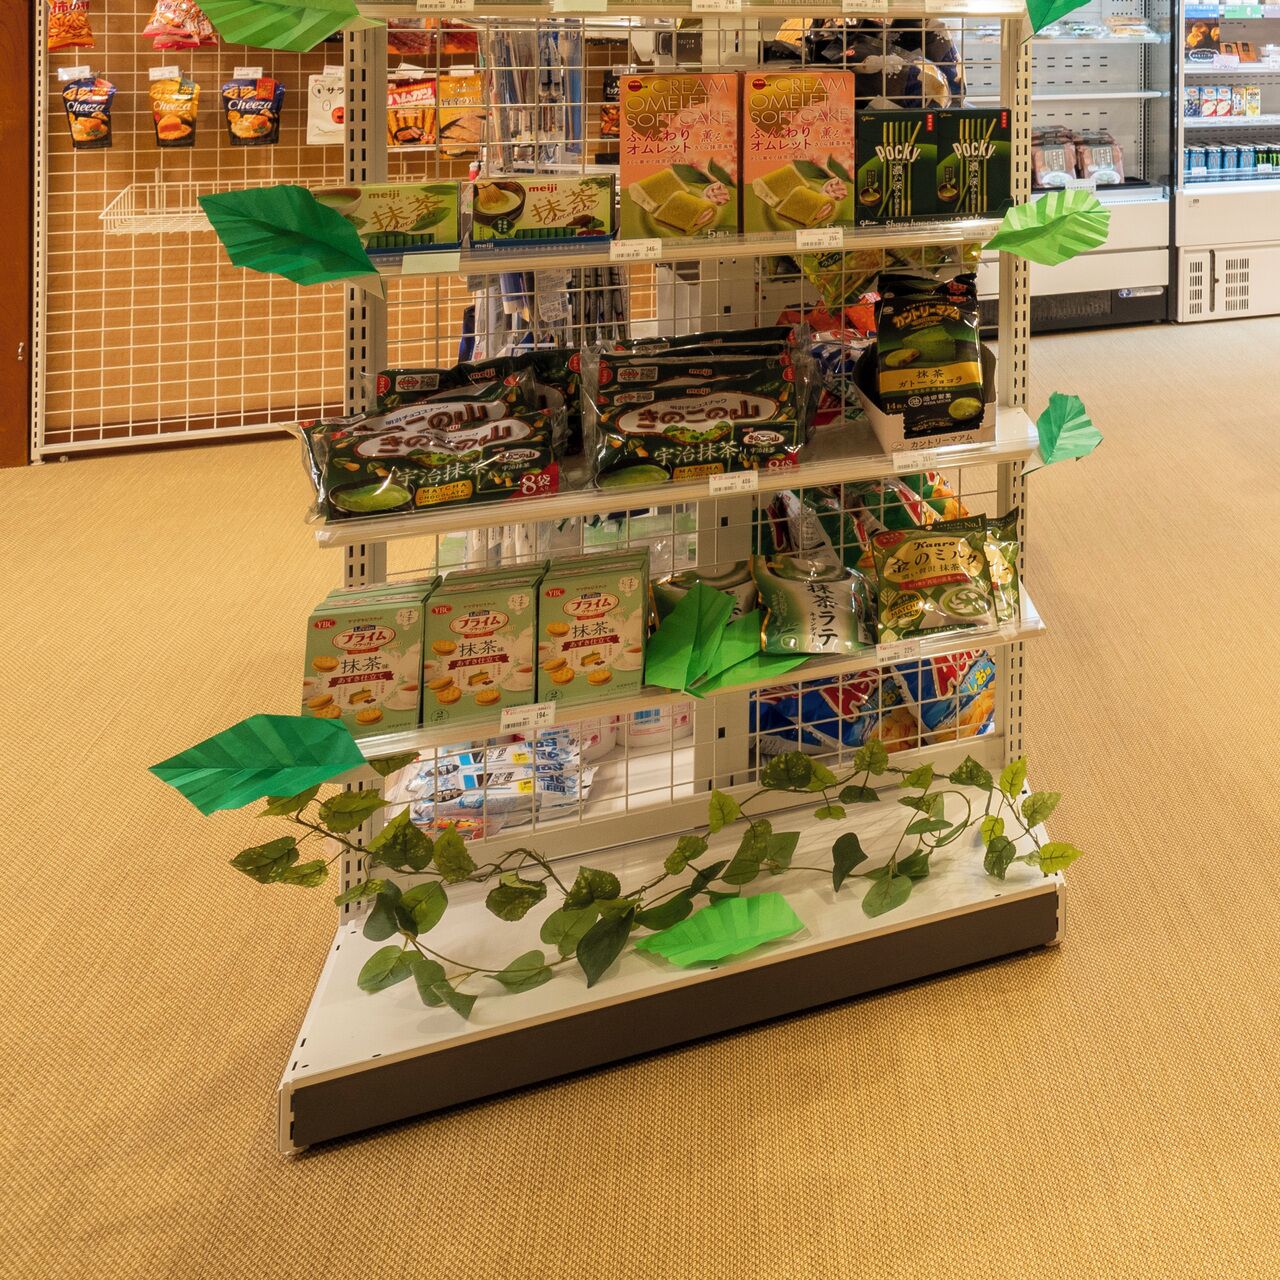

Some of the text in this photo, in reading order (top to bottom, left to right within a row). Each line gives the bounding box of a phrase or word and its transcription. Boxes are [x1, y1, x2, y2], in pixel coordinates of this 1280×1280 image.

[651, 79, 728, 95] CREAM
[774, 77, 847, 93] CREAM
[66, 100, 105, 113] Cheeza
[152, 100, 192, 112] Cheeza
[227, 98, 273, 111] Cheeza
[626, 95, 710, 112] OMELET
[751, 93, 830, 110] OMELET
[626, 110, 730, 128] SOFT CAKE
[751, 108, 849, 125] SOFT CAKE
[626, 129, 690, 142] ふんわり
[751, 127, 811, 139] ふんわり
[627, 142, 692, 155] オムレット
[751, 140, 812, 152] オムレット
[528, 183, 558, 193] meiji
[368, 190, 401, 200] meiji
[531, 186, 599, 224] 抹茶
[916, 369, 945, 380] 抹茶
[898, 376, 963, 389] ガトーショコラ
[637, 400, 760, 429] きのこの山
[653, 440, 738, 466] 宇治抹茶
[396, 463, 490, 486] 宇治抹茶
[422, 482, 468, 495] MATCHA
[913, 539, 956, 552] Kanro
[546, 588, 563, 597] YBC
[433, 605, 450, 614] YBC
[570, 598, 612, 611] プライム
[806, 583, 839, 648] 抹茶ラテ
[317, 620, 333, 629] YBC
[458, 616, 501, 629] プライム
[342, 631, 388, 644] プライム
[568, 636, 613, 648] あずき仕立て
[455, 655, 500, 668] あずき仕立て
[335, 672, 386, 686] あずき仕立て
